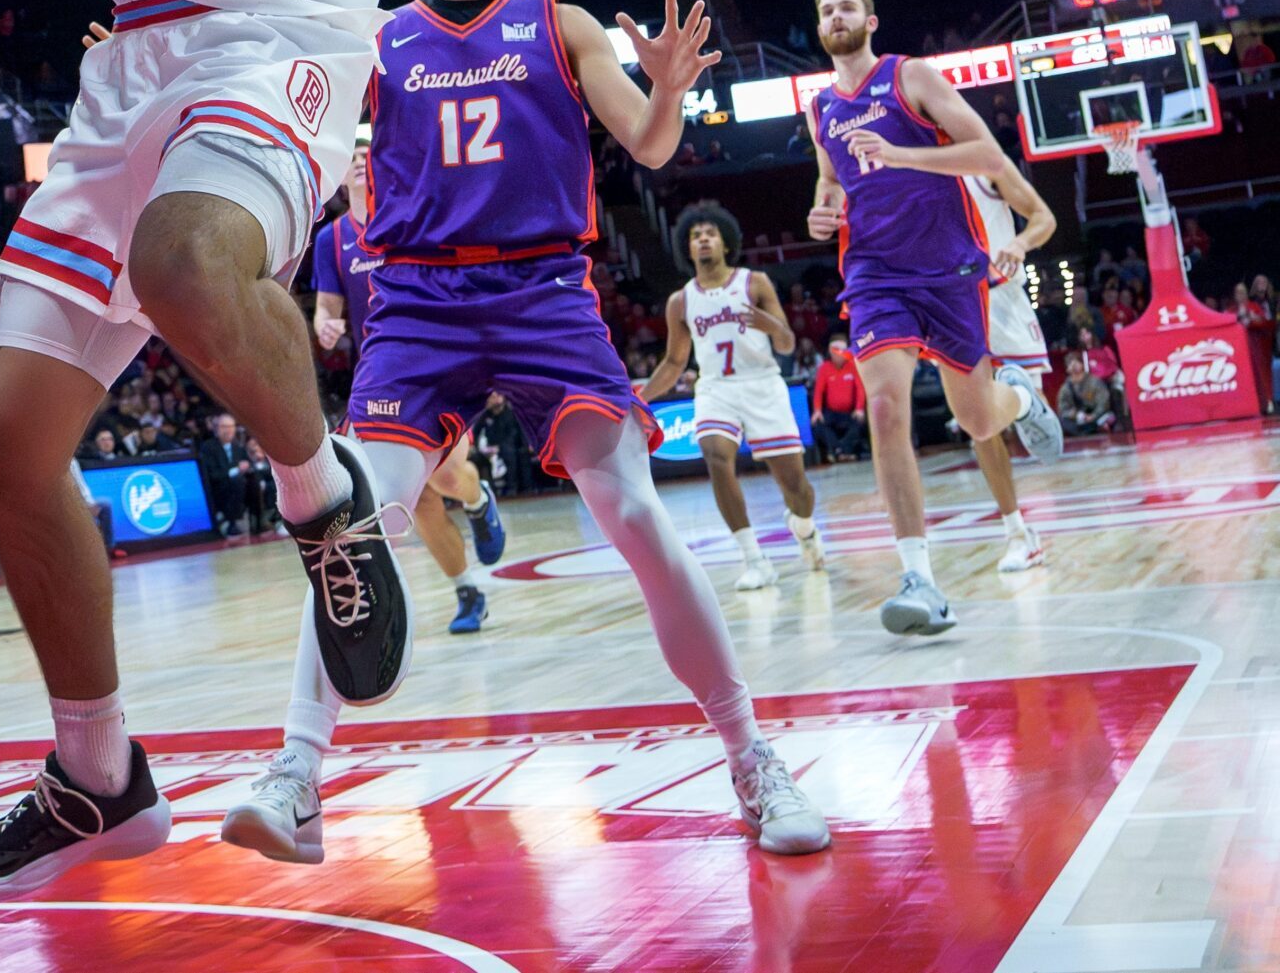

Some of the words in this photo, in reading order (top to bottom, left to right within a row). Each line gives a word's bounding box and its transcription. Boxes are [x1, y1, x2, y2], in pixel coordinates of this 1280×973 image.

[404, 53, 529, 92] Evansville
[439, 95, 504, 167] 12
[828, 100, 887, 139] Evansville
[694, 306, 747, 334] Bradley
[716, 340, 735, 376] 7
[1137, 356, 1237, 392] Club
[367, 399, 401, 416] VALLEY
